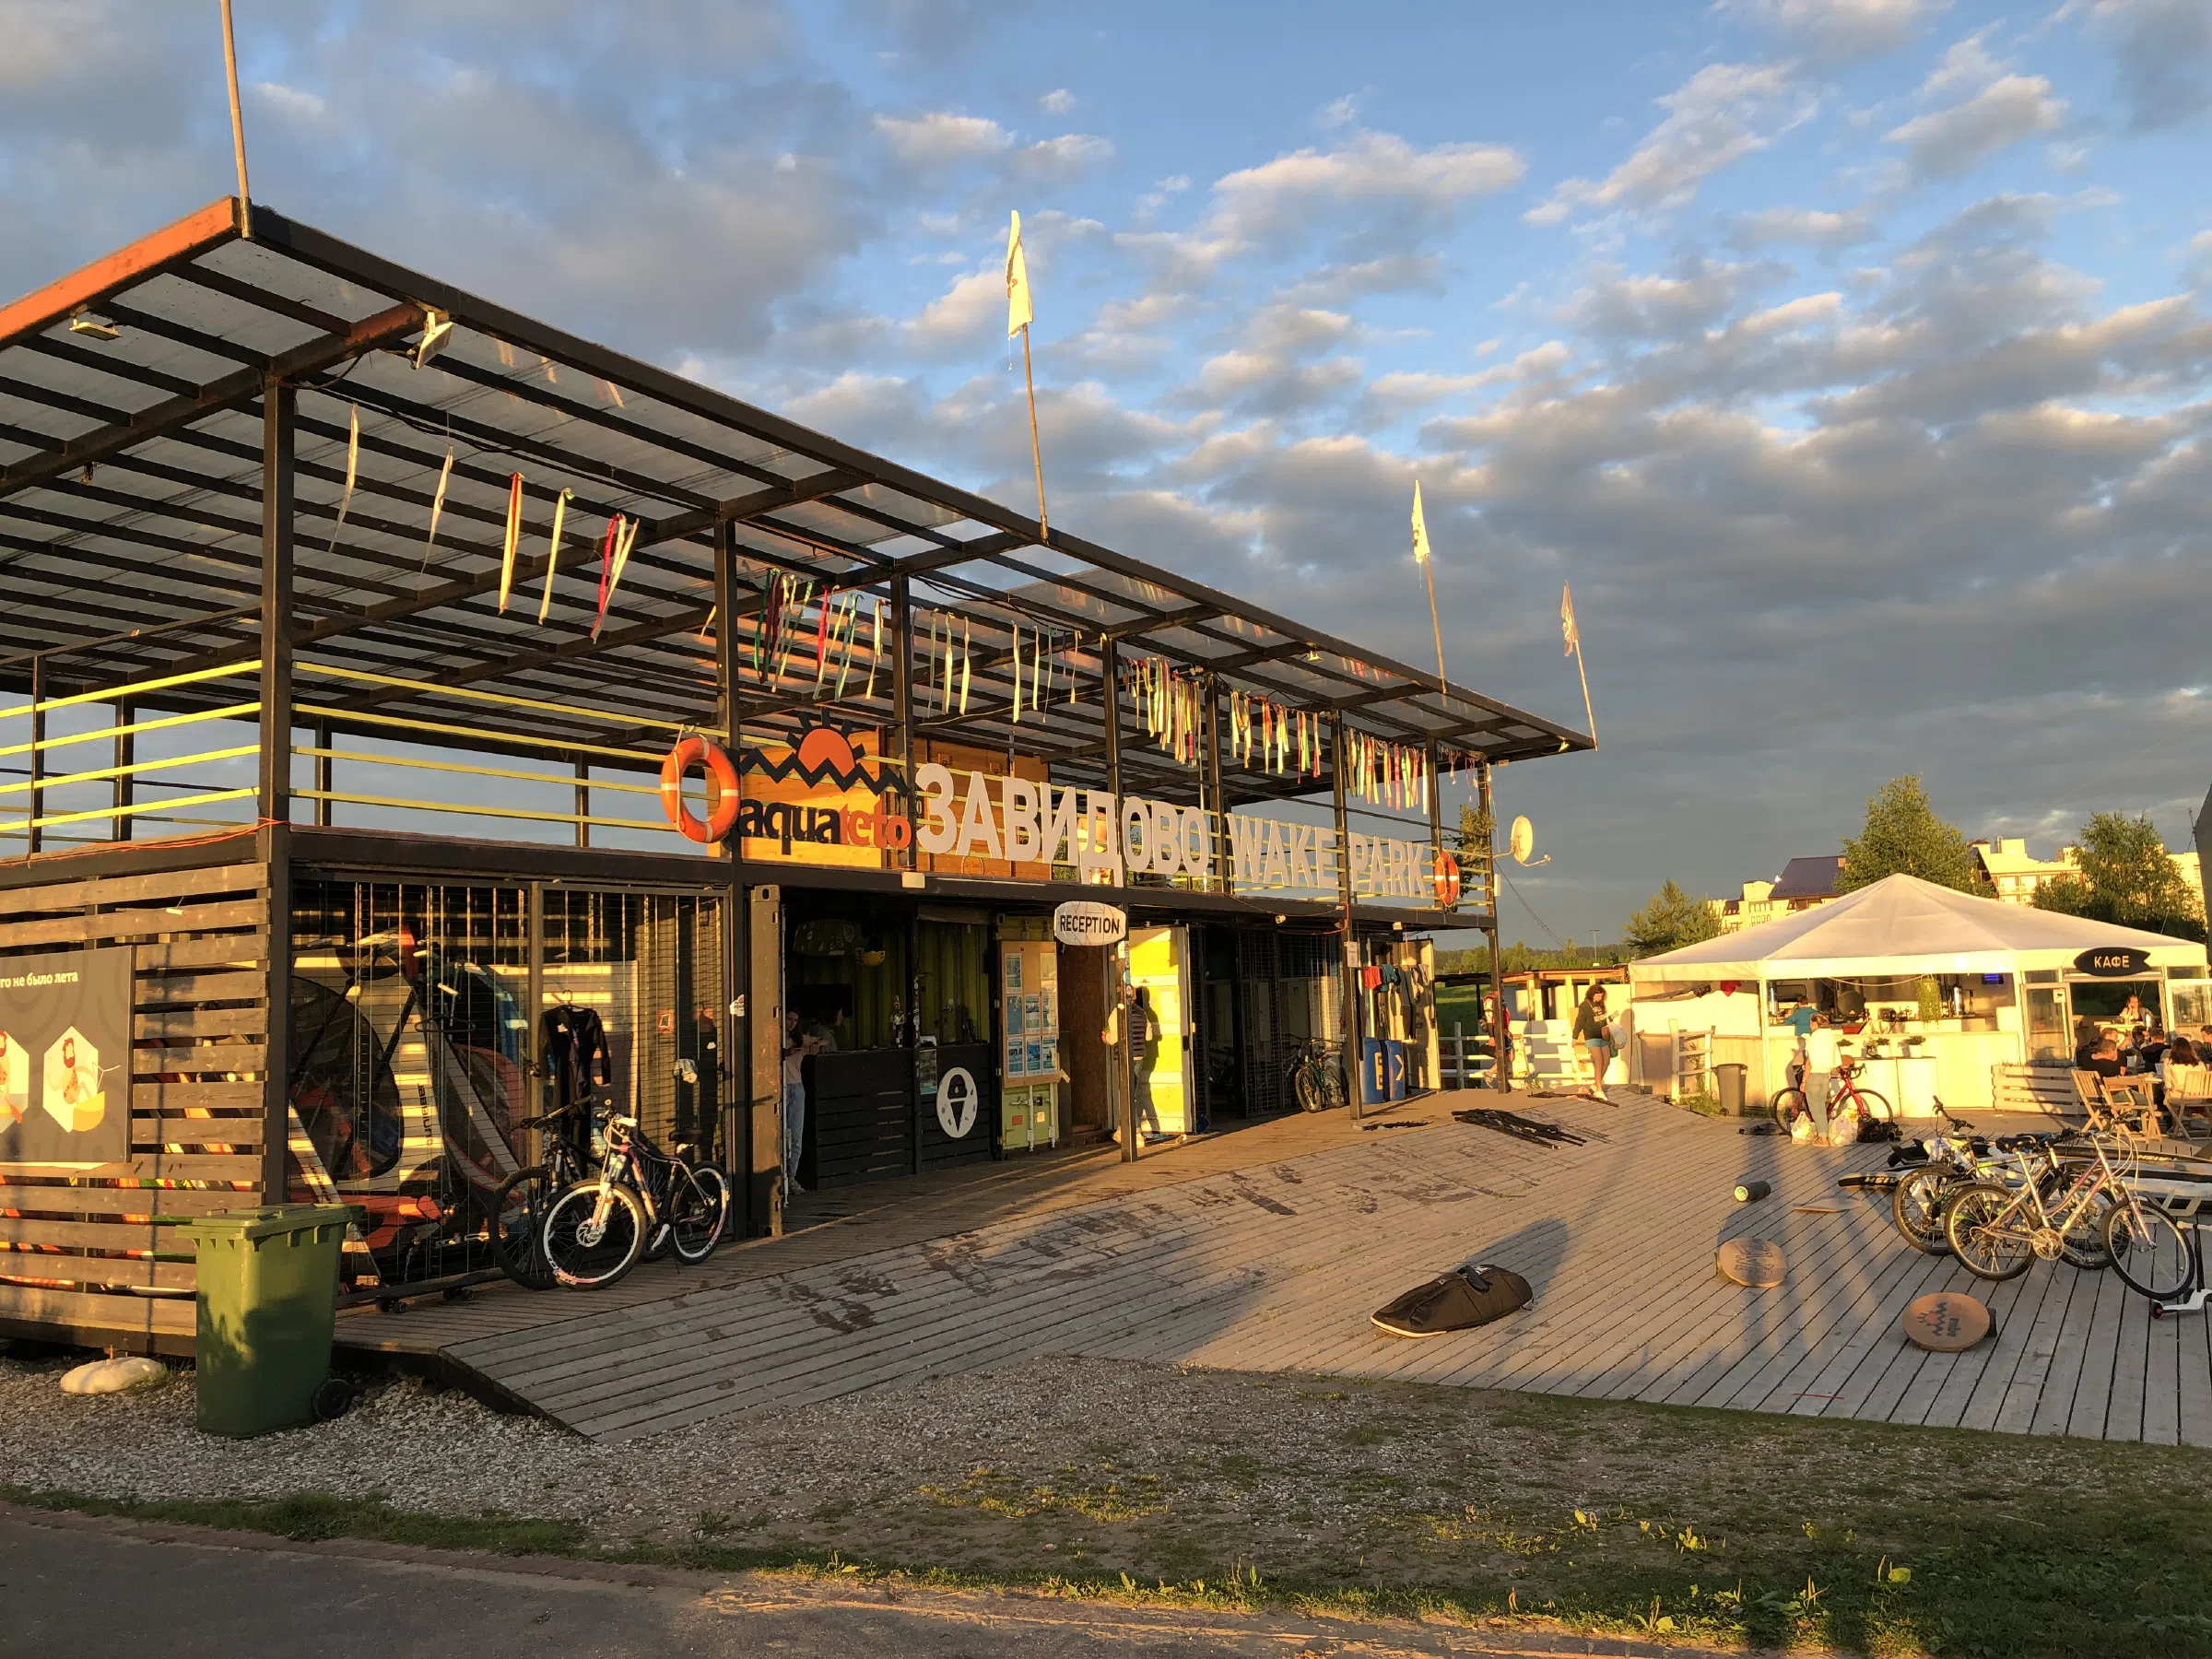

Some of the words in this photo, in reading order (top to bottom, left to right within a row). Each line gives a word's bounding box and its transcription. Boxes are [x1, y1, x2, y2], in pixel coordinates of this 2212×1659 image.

[738, 798, 912, 855] aquateto
[915, 763, 1209, 888] ЗАВИДОВО
[1227, 812, 1336, 890] WAKE
[1348, 831, 1428, 900] PARK
[1060, 914, 1120, 935] RECEPTION
[13, 976, 25, 987] не
[27, 972, 53, 986] было
[54, 971, 78, 983] лета
[2094, 955, 2130, 969] КАФЕ
